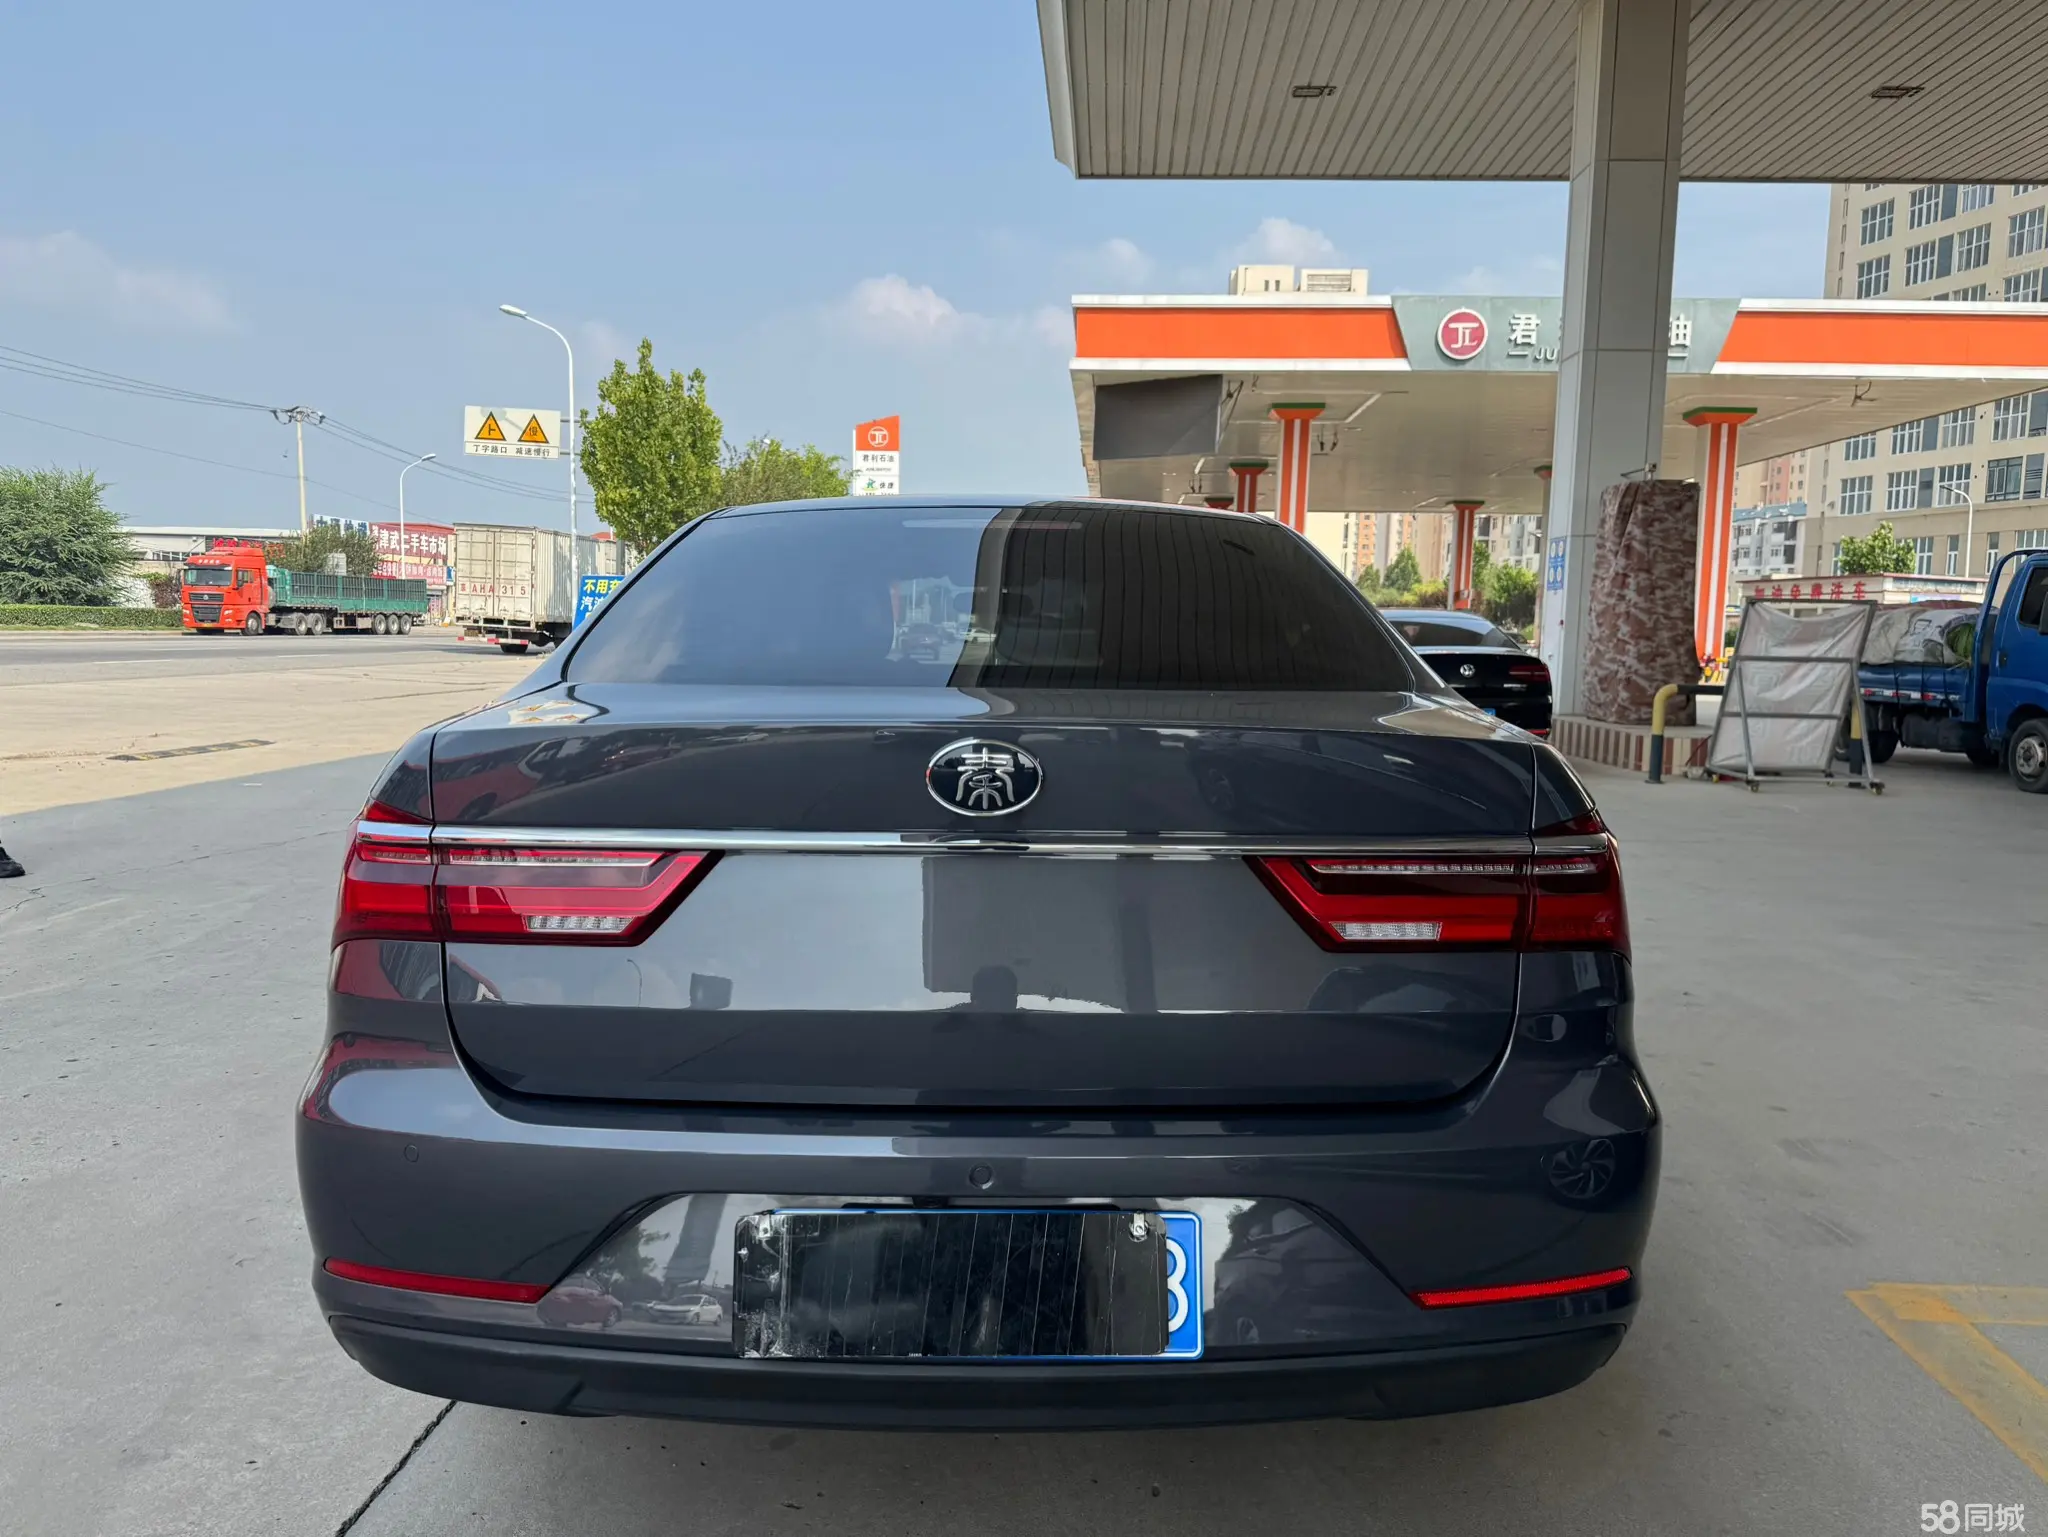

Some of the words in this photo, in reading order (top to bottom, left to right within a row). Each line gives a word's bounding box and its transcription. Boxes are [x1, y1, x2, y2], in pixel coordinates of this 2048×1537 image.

[473, 444, 508, 454] 丁字路口
[515, 447, 551, 457] 减速慢行
[862, 454, 895, 463] 君利石油
